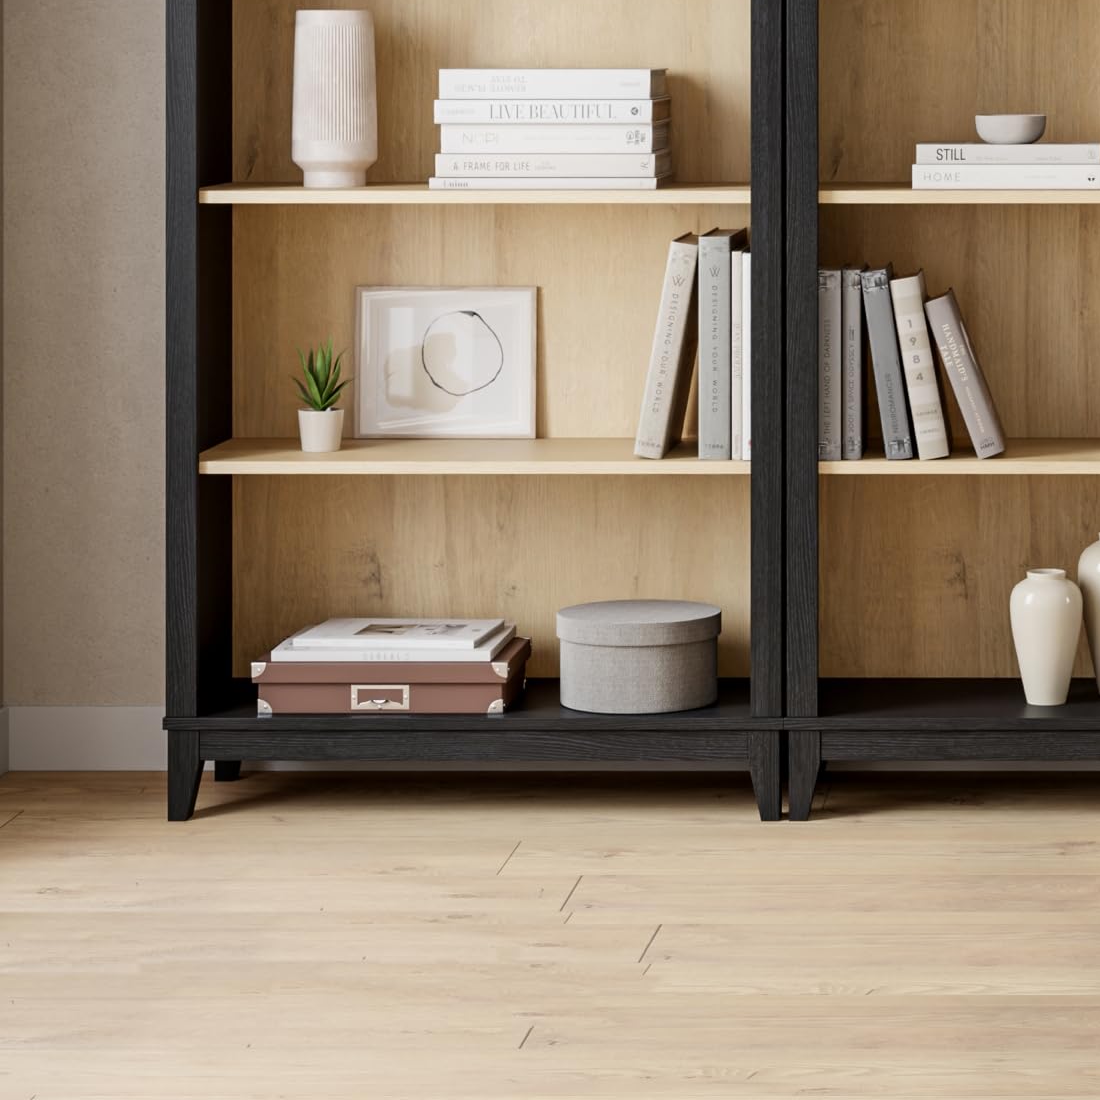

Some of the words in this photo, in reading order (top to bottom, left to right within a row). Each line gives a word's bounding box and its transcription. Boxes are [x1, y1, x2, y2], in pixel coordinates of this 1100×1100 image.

[489, 103, 525, 119] LIVE
[529, 103, 616, 119] BEAUTIFUL
[936, 148, 966, 161] STILL
[463, 161, 491, 171] FRAME
[495, 161, 510, 171] FOR
[513, 161, 531, 171] LIFE
[923, 172, 961, 182] HOME
[664, 293, 679, 345] DESIGNING
[823, 318, 831, 358] DARKNESS
[941, 323, 969, 382] HANDMAID'S
[823, 361, 831, 372] OF
[823, 375, 831, 398] HAND
[652, 381, 663, 413] WORLD
[823, 402, 831, 417] LEFT
[823, 421, 831, 434] THE
